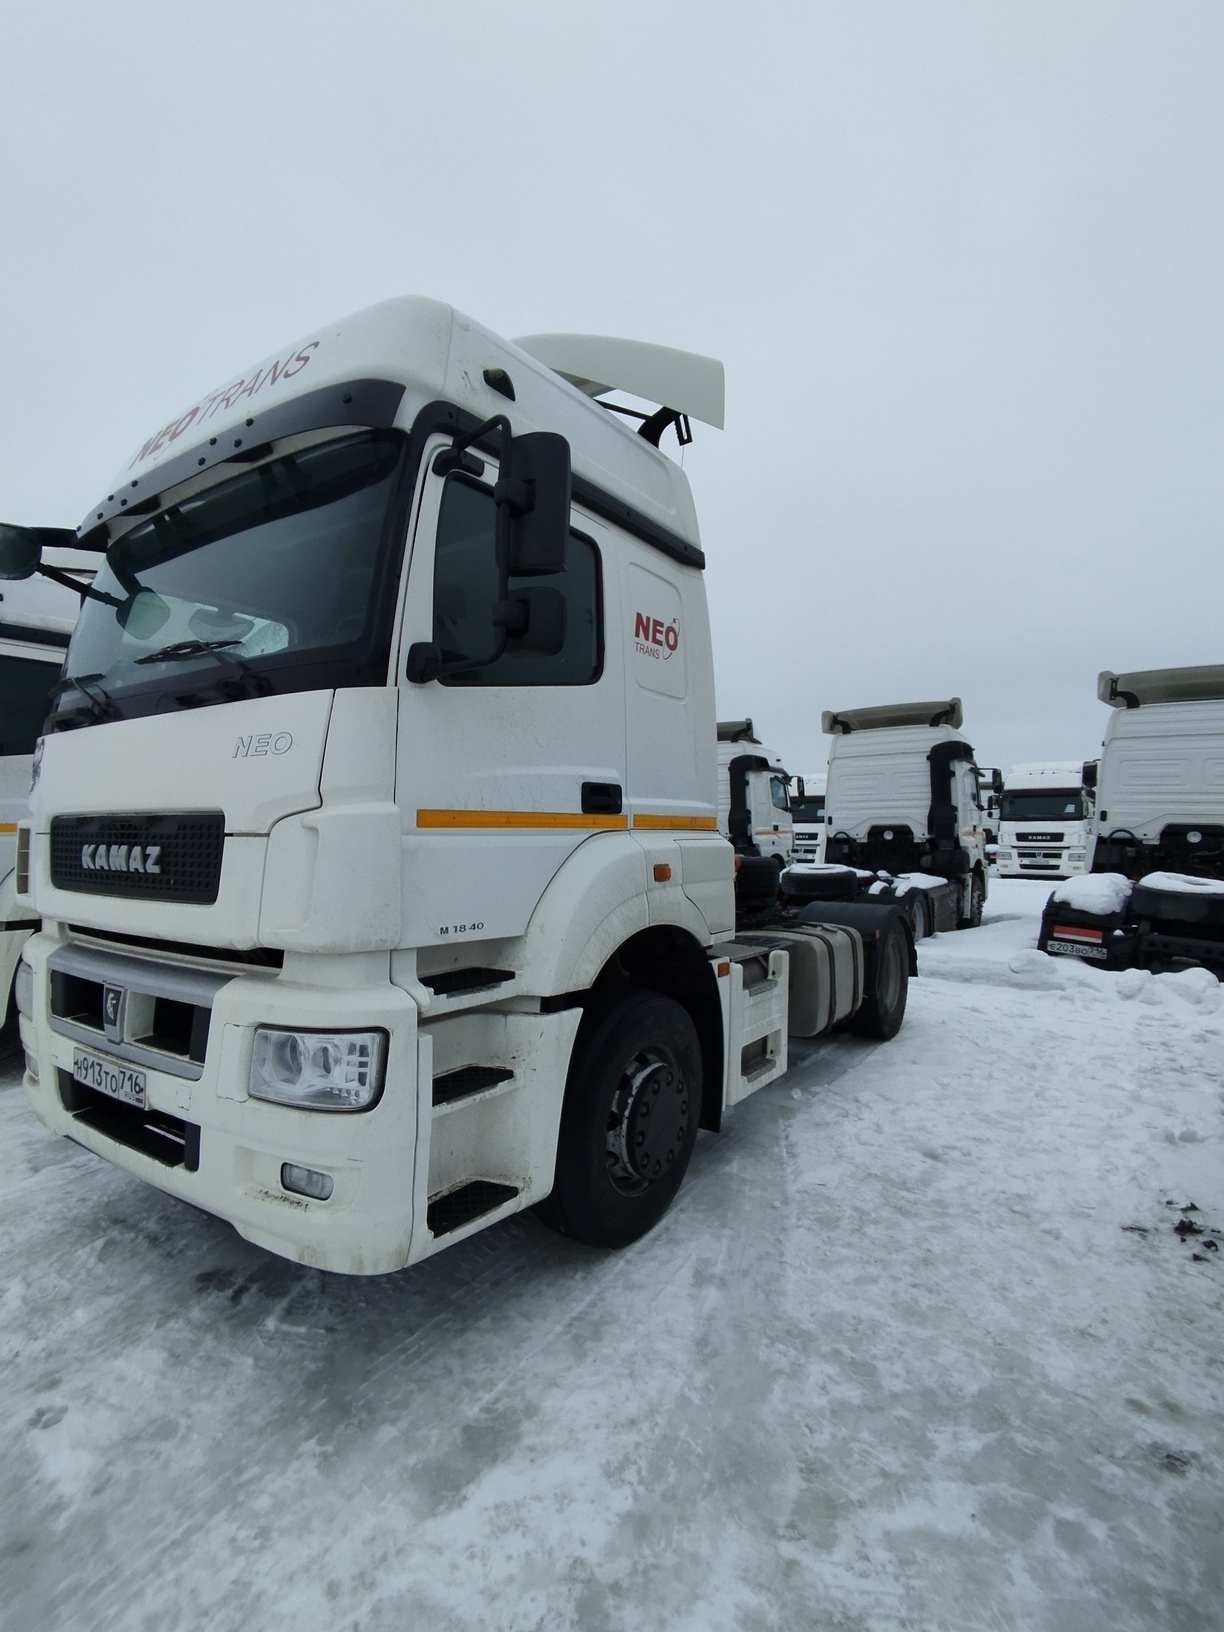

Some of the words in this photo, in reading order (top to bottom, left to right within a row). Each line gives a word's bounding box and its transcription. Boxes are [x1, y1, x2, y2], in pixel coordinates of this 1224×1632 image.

[128, 406, 201, 470] NEO
[208, 340, 320, 418] TRANS
[634, 611, 679, 652] NEO
[634, 641, 660, 660] TRANS
[231, 731, 293, 758] NEO
[80, 844, 161, 874] KAMAZ
